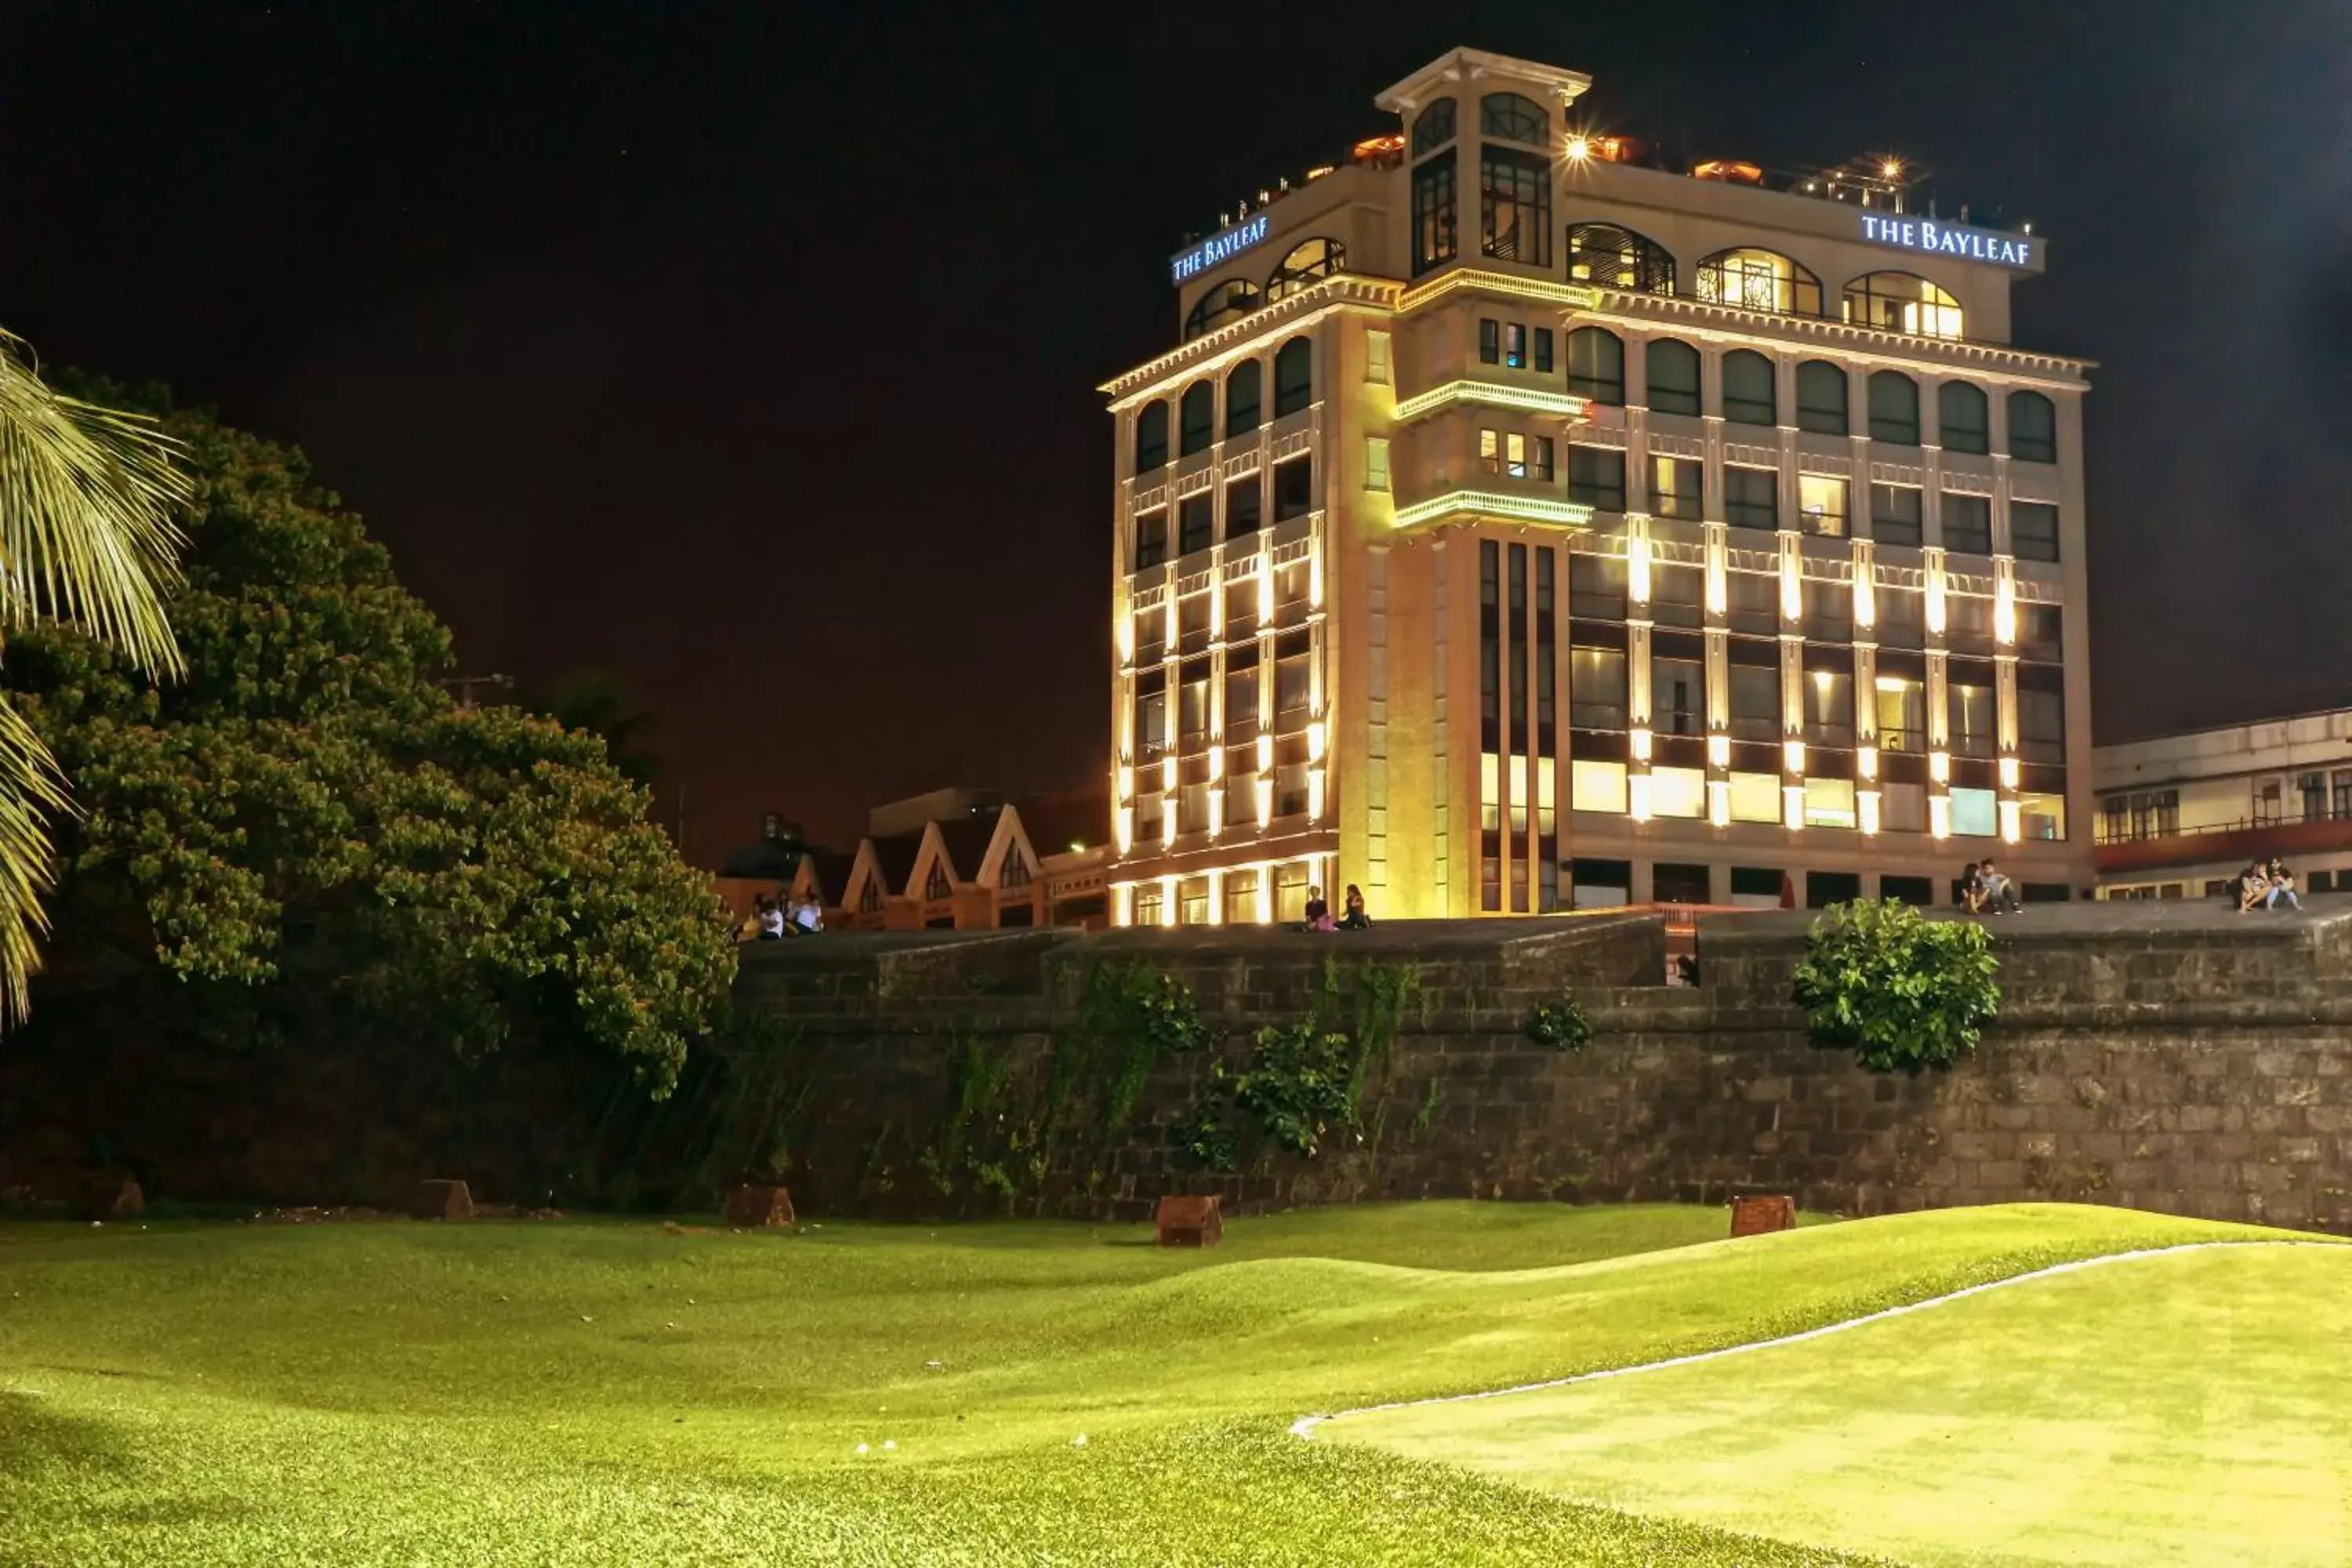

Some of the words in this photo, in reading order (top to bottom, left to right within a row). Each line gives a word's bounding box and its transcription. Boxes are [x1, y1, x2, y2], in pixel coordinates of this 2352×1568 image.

[1173, 252, 1201, 280] THE
[1205, 216, 1267, 266] BAYLEAF
[1862, 216, 1914, 245] THE
[1922, 222, 2029, 264] BAYLEAF
